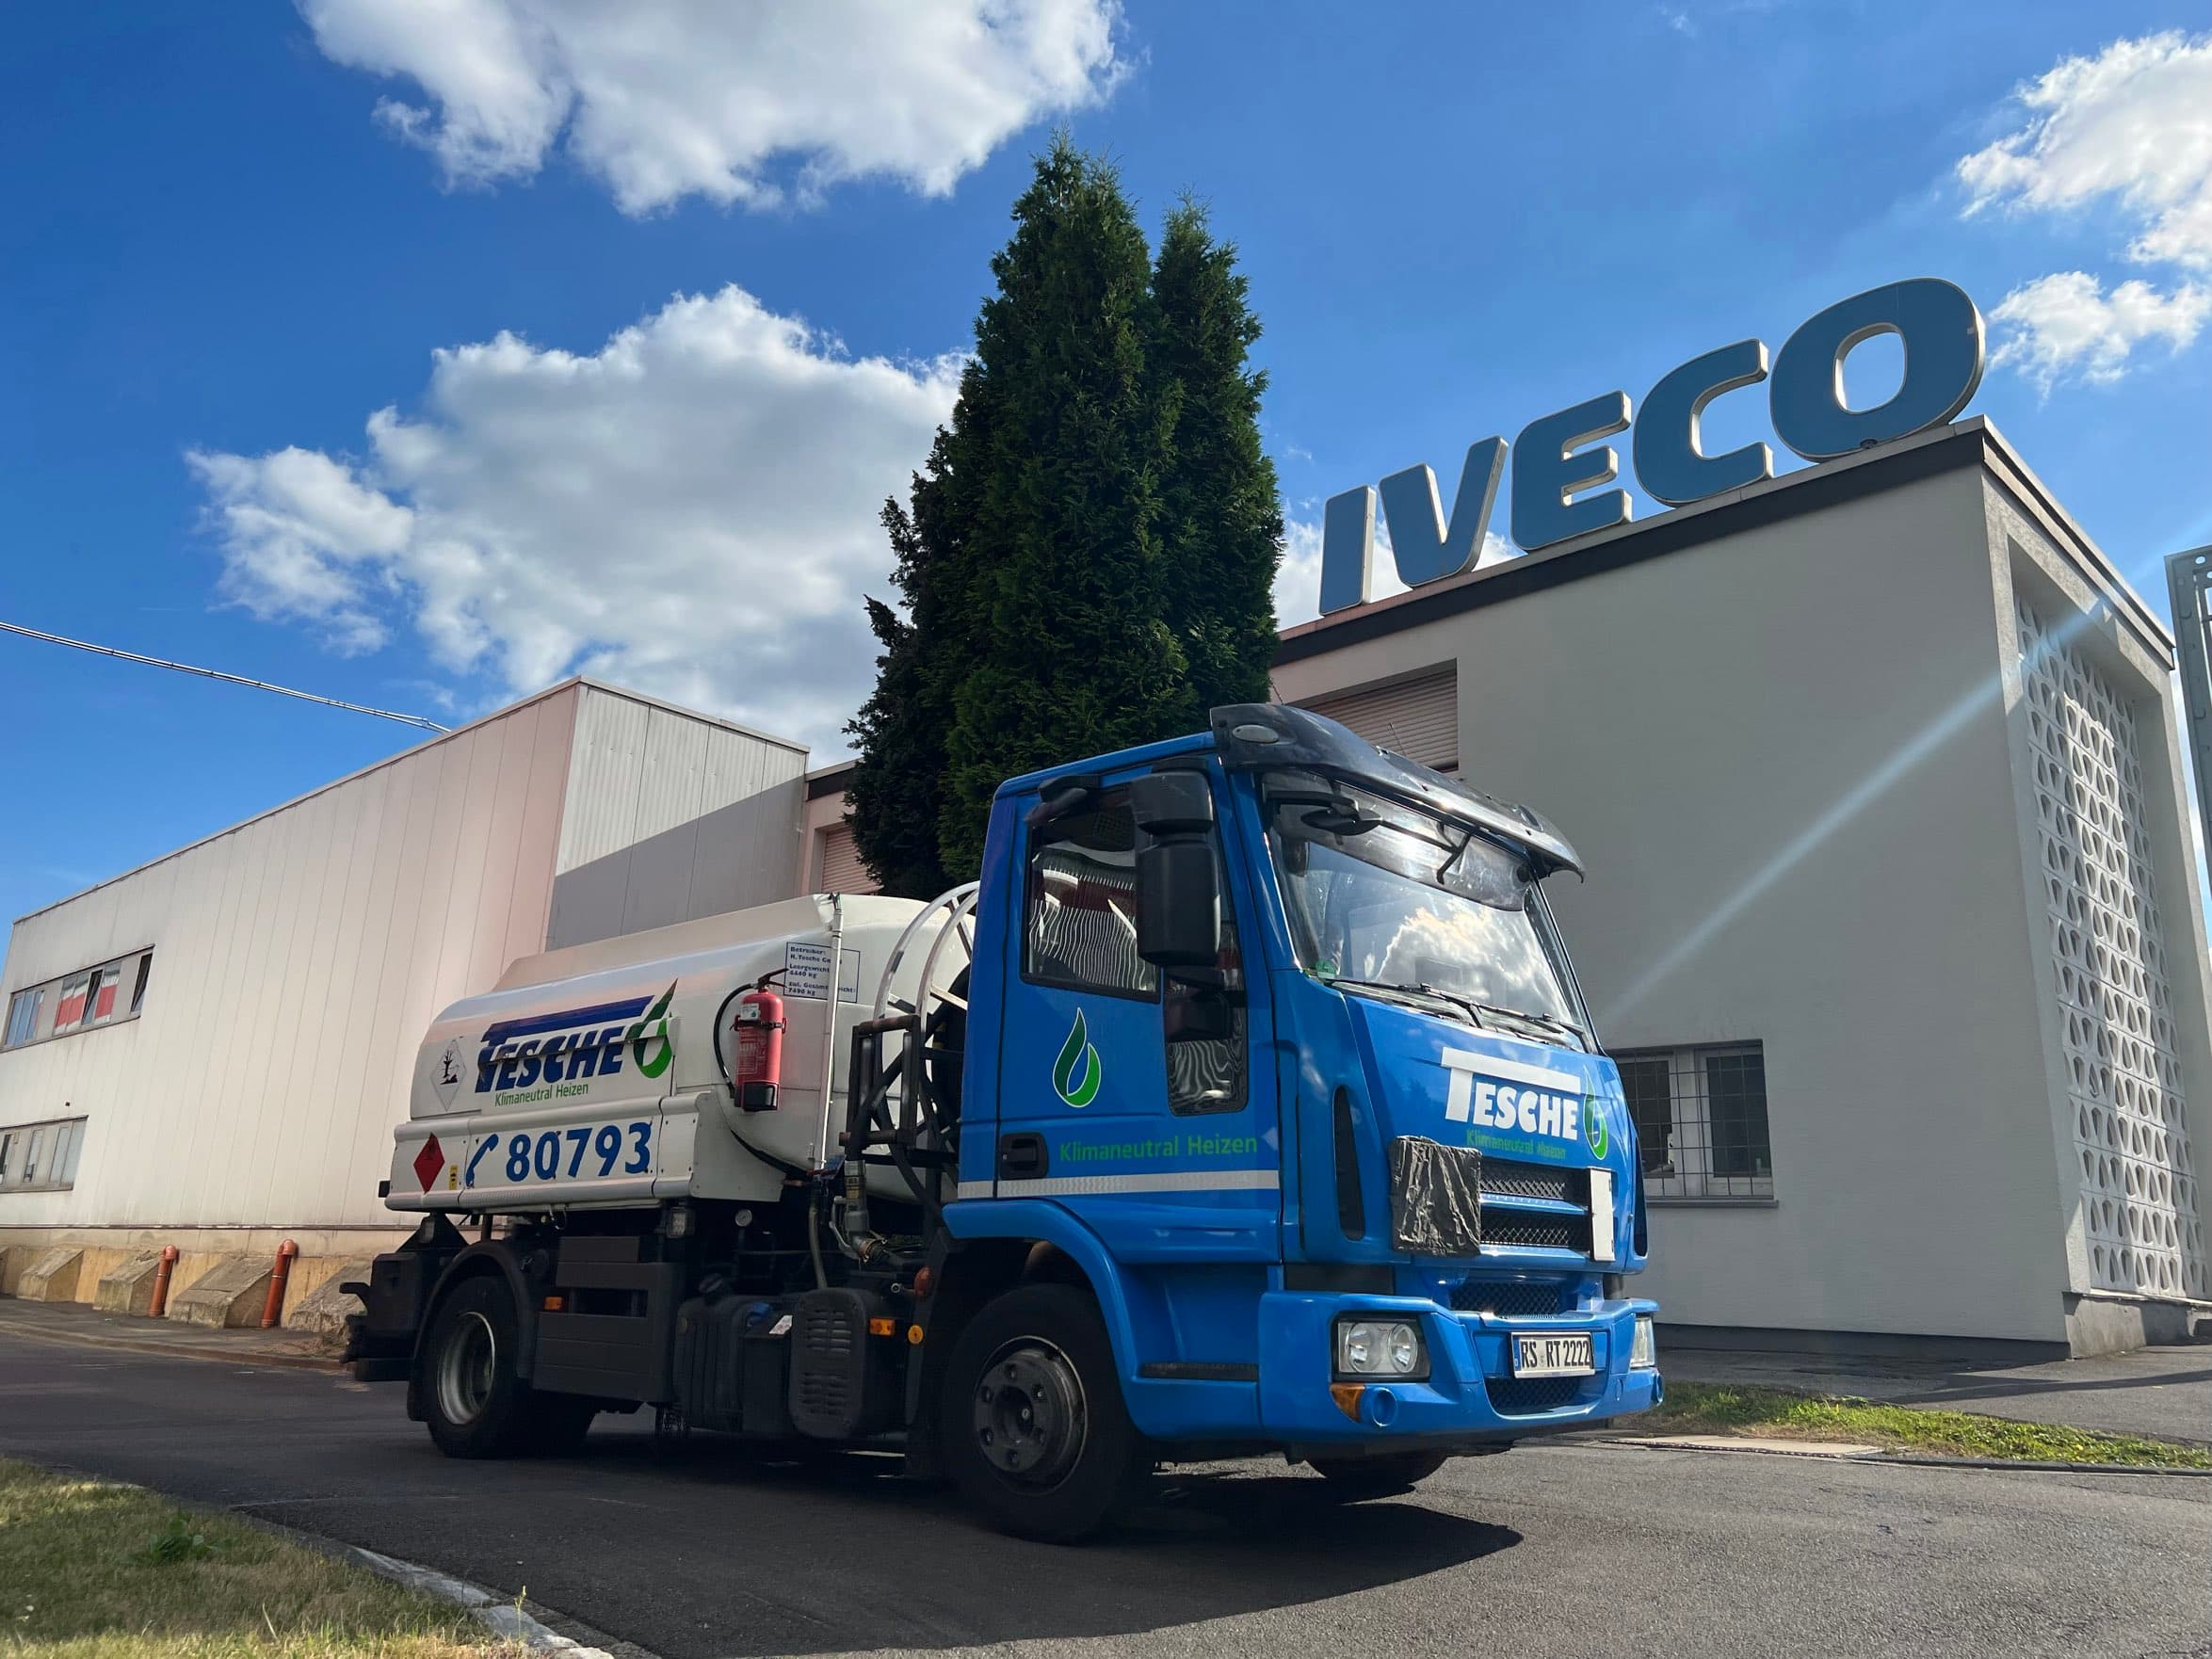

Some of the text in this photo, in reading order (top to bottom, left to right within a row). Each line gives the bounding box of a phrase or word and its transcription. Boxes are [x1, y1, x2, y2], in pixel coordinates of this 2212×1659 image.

[1318, 277, 1986, 616] IVECO
[475, 995, 655, 1093] TESCHE
[494, 1083, 589, 1107] Klimaneutral Heizen
[1441, 1046, 1581, 1140] TESCHE
[506, 1122, 652, 1182] 80793
[1059, 1133, 1258, 1161] Klimaneutral Heizen
[1520, 1340, 1538, 1368] RS
[1545, 1340, 1561, 1368] RT
[1563, 1340, 1591, 1367] 2222
